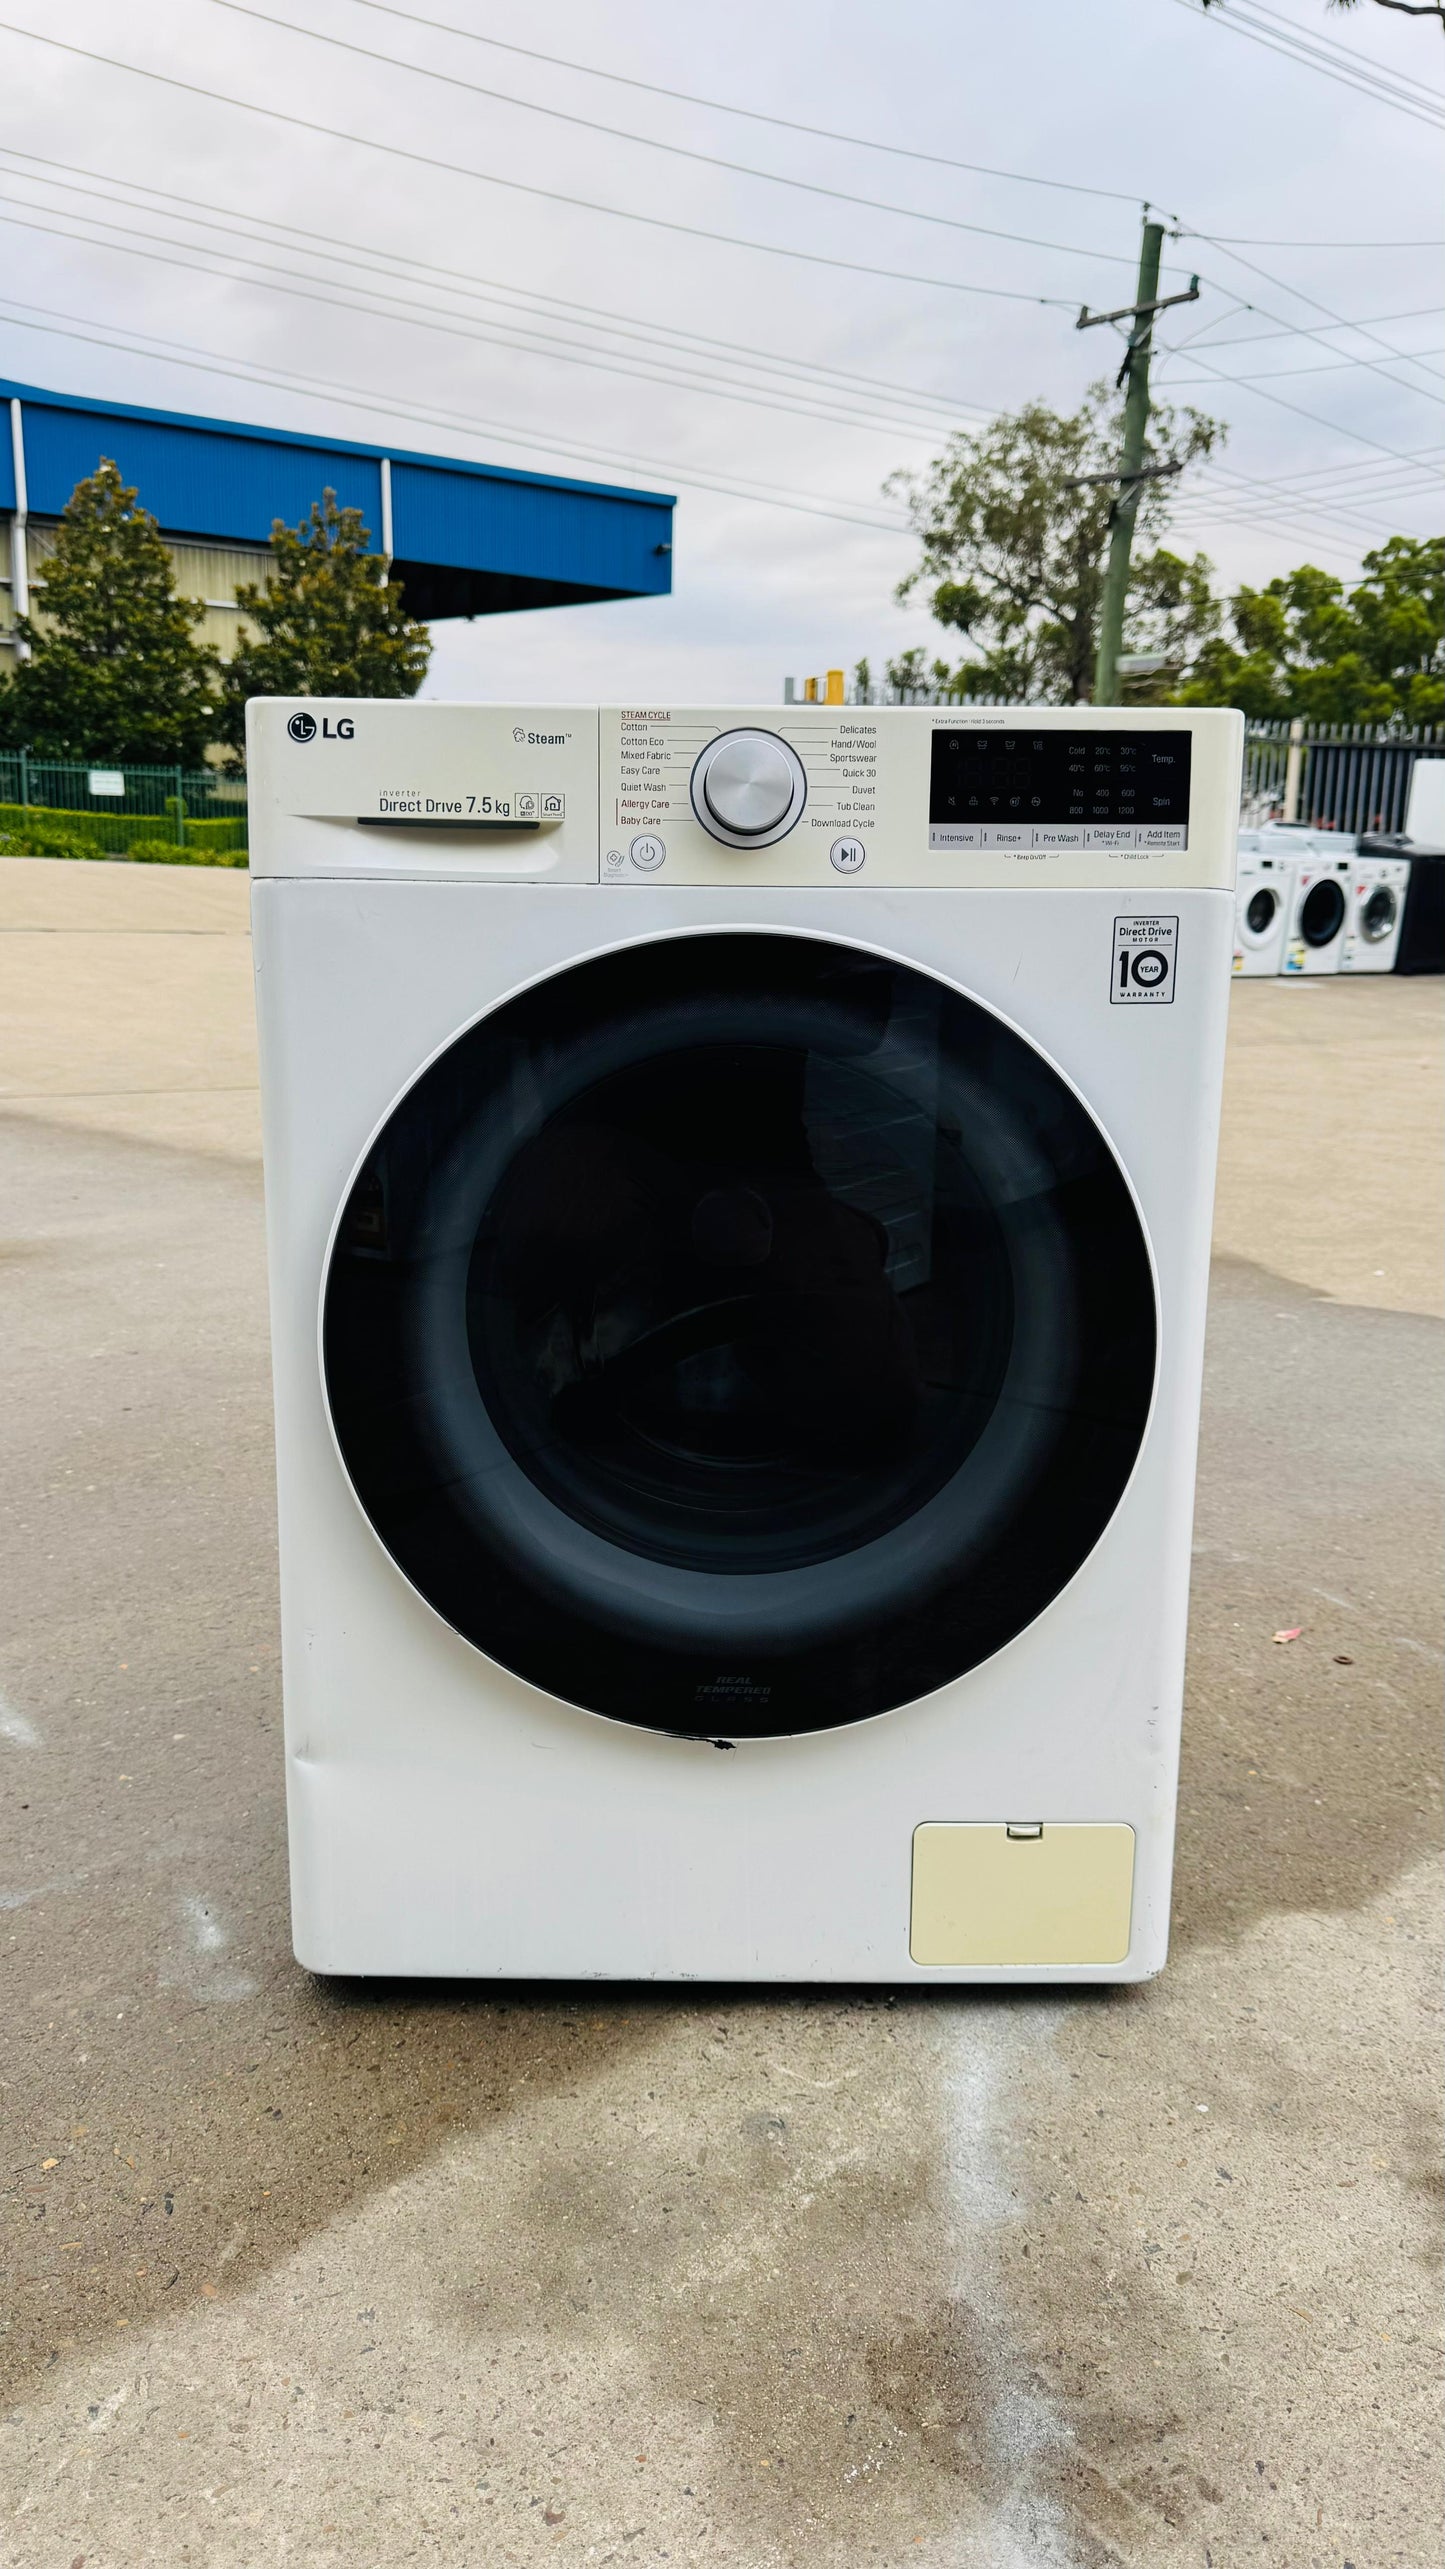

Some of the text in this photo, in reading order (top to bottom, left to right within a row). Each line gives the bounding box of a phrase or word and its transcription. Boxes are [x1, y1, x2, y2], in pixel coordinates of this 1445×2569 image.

[621, 711, 671, 720] STEAM CYCLE
[322, 718, 355, 739] LG
[621, 722, 648, 732] Cotton
[840, 726, 877, 734] Delicates
[621, 737, 664, 746] Cotton Eco
[831, 740, 876, 749] Hand/Wool
[1069, 746, 1086, 755] Cold
[621, 751, 671, 760] Mixed Fabric
[830, 754, 877, 764] Sportswear
[1152, 754, 1176, 764] Temp.
[621, 766, 660, 776] Easy Care
[842, 768, 876, 778] Quick 30
[621, 782, 666, 792] Quiet Wash
[852, 786, 875, 794] Duvet
[1073, 789, 1135, 797] No 400 600
[379, 796, 510, 817] Direct Drive 7.5 kg
[621, 800, 670, 810] Allergy Care
[837, 802, 875, 811] Tub Clean
[1153, 797, 1170, 807] Spin
[1069, 806, 1134, 814] 800 1000 1200
[621, 816, 661, 826] Baby Care
[812, 818, 875, 829] Download Cycle
[940, 833, 974, 842] Intensive
[1043, 834, 1079, 842] Pre Wash
[1094, 830, 1130, 839] Delay End
[1120, 927, 1172, 936] Direct Drive
[1119, 950, 1169, 988] 10
[716, 1676, 752, 1684] REAL
[696, 1686, 771, 1694] TEMPERED
